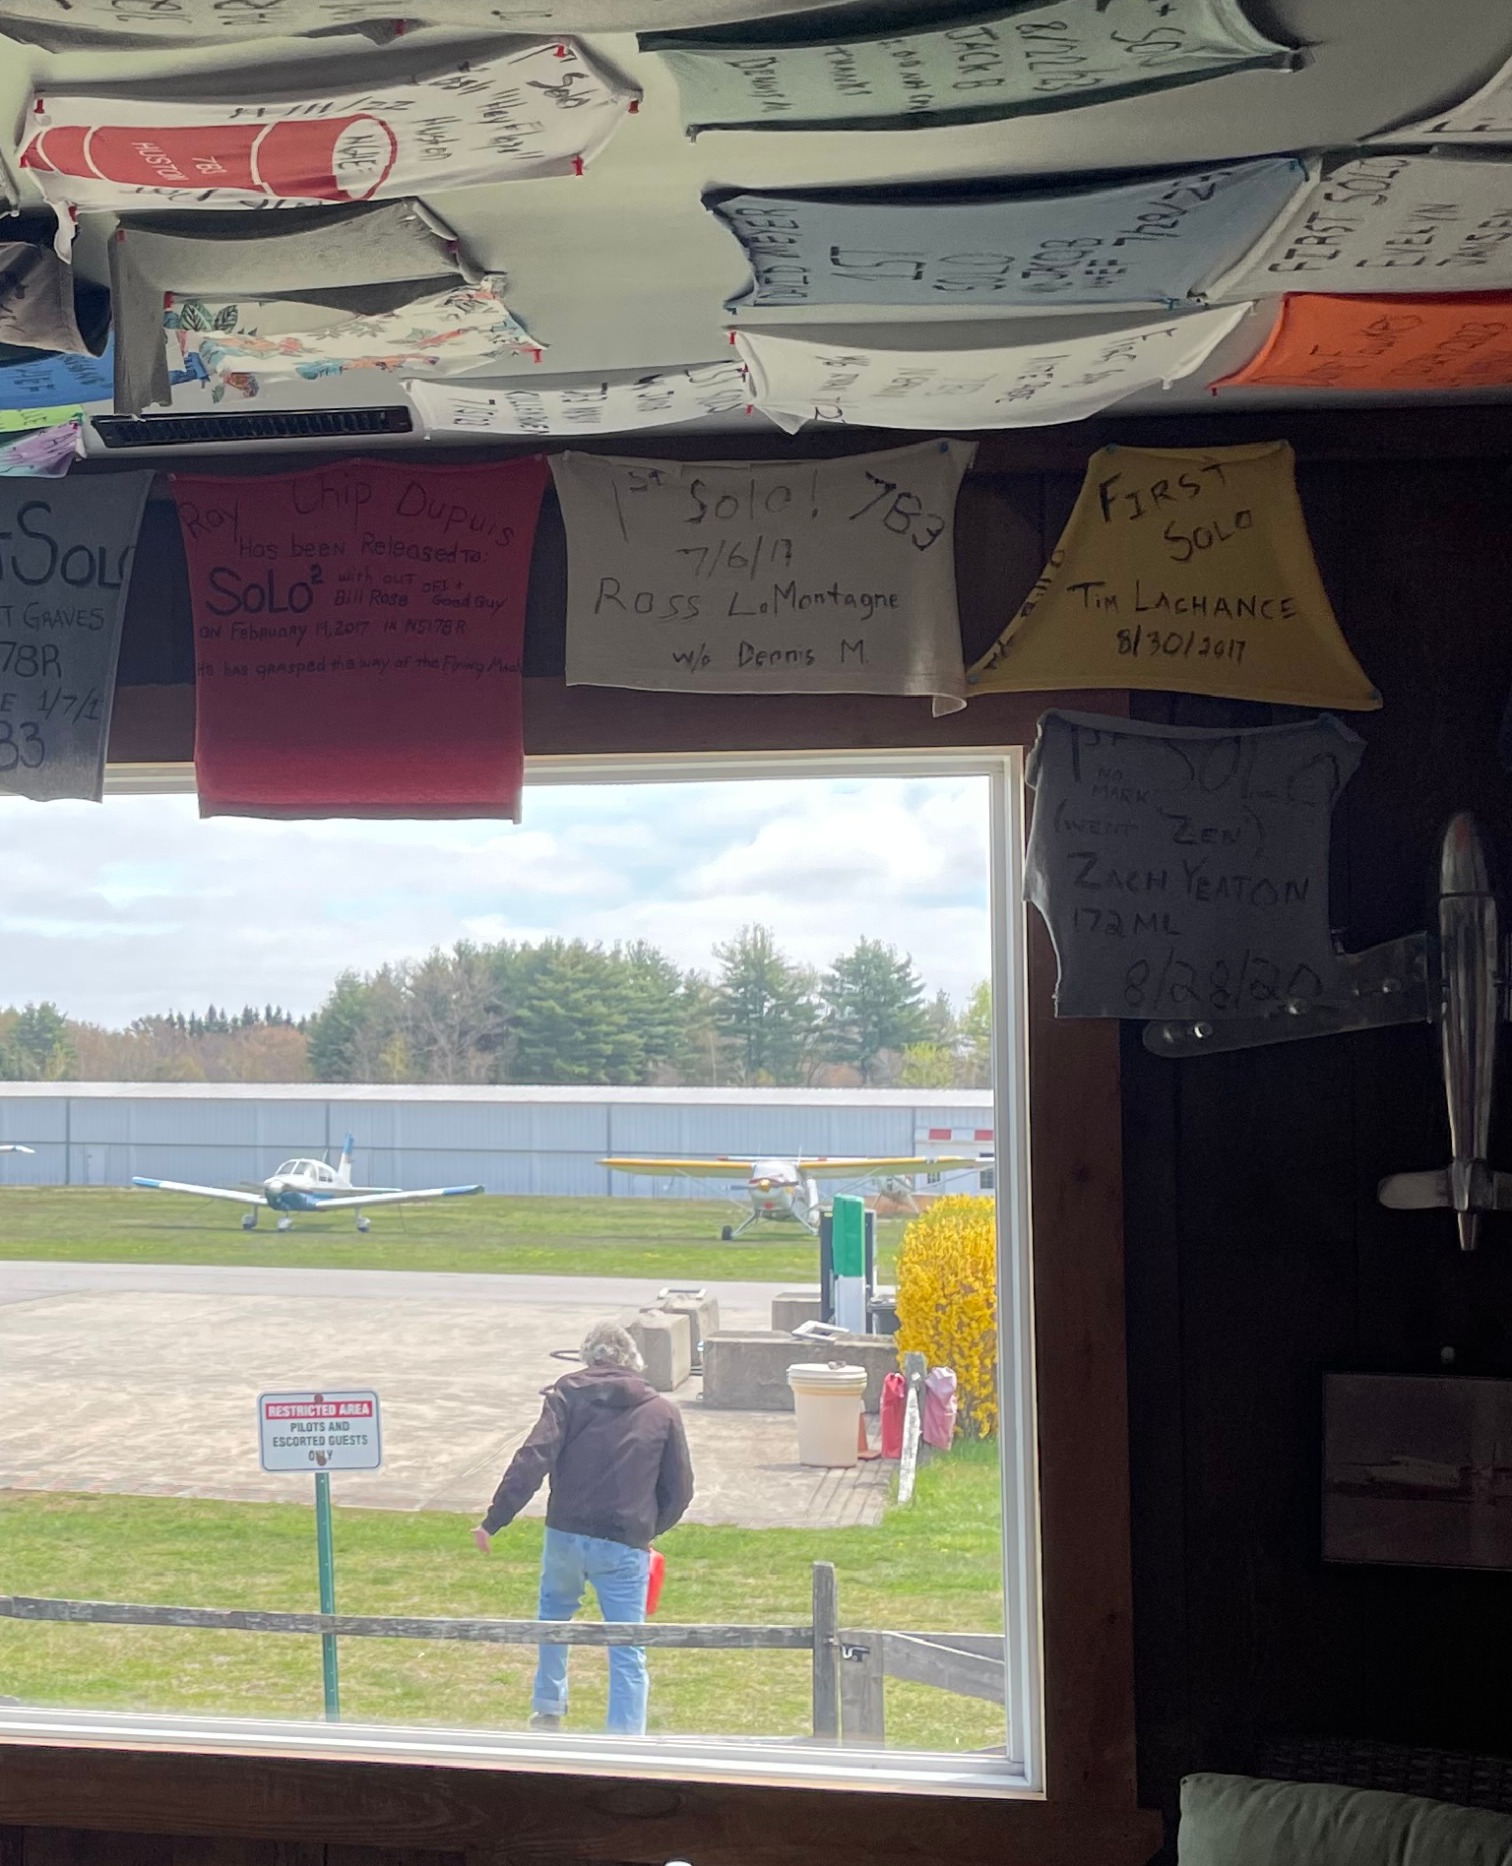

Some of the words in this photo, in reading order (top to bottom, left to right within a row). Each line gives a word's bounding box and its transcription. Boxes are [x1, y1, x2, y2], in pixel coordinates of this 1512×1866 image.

[1098, 462, 1227, 524] FIRST
[1163, 508, 1254, 563] SOLO
[1116, 624, 1246, 667] 8/30/2017
[1066, 851, 1170, 894] ZACH
[268, 1404, 336, 1418] RESTRICTED
[338, 1403, 371, 1416] AREA
[290, 1421, 326, 1433] PILOTS
[328, 1421, 350, 1432] AND
[272, 1436, 326, 1448] ESCORTED
[328, 1434, 369, 1447] GUESTS
